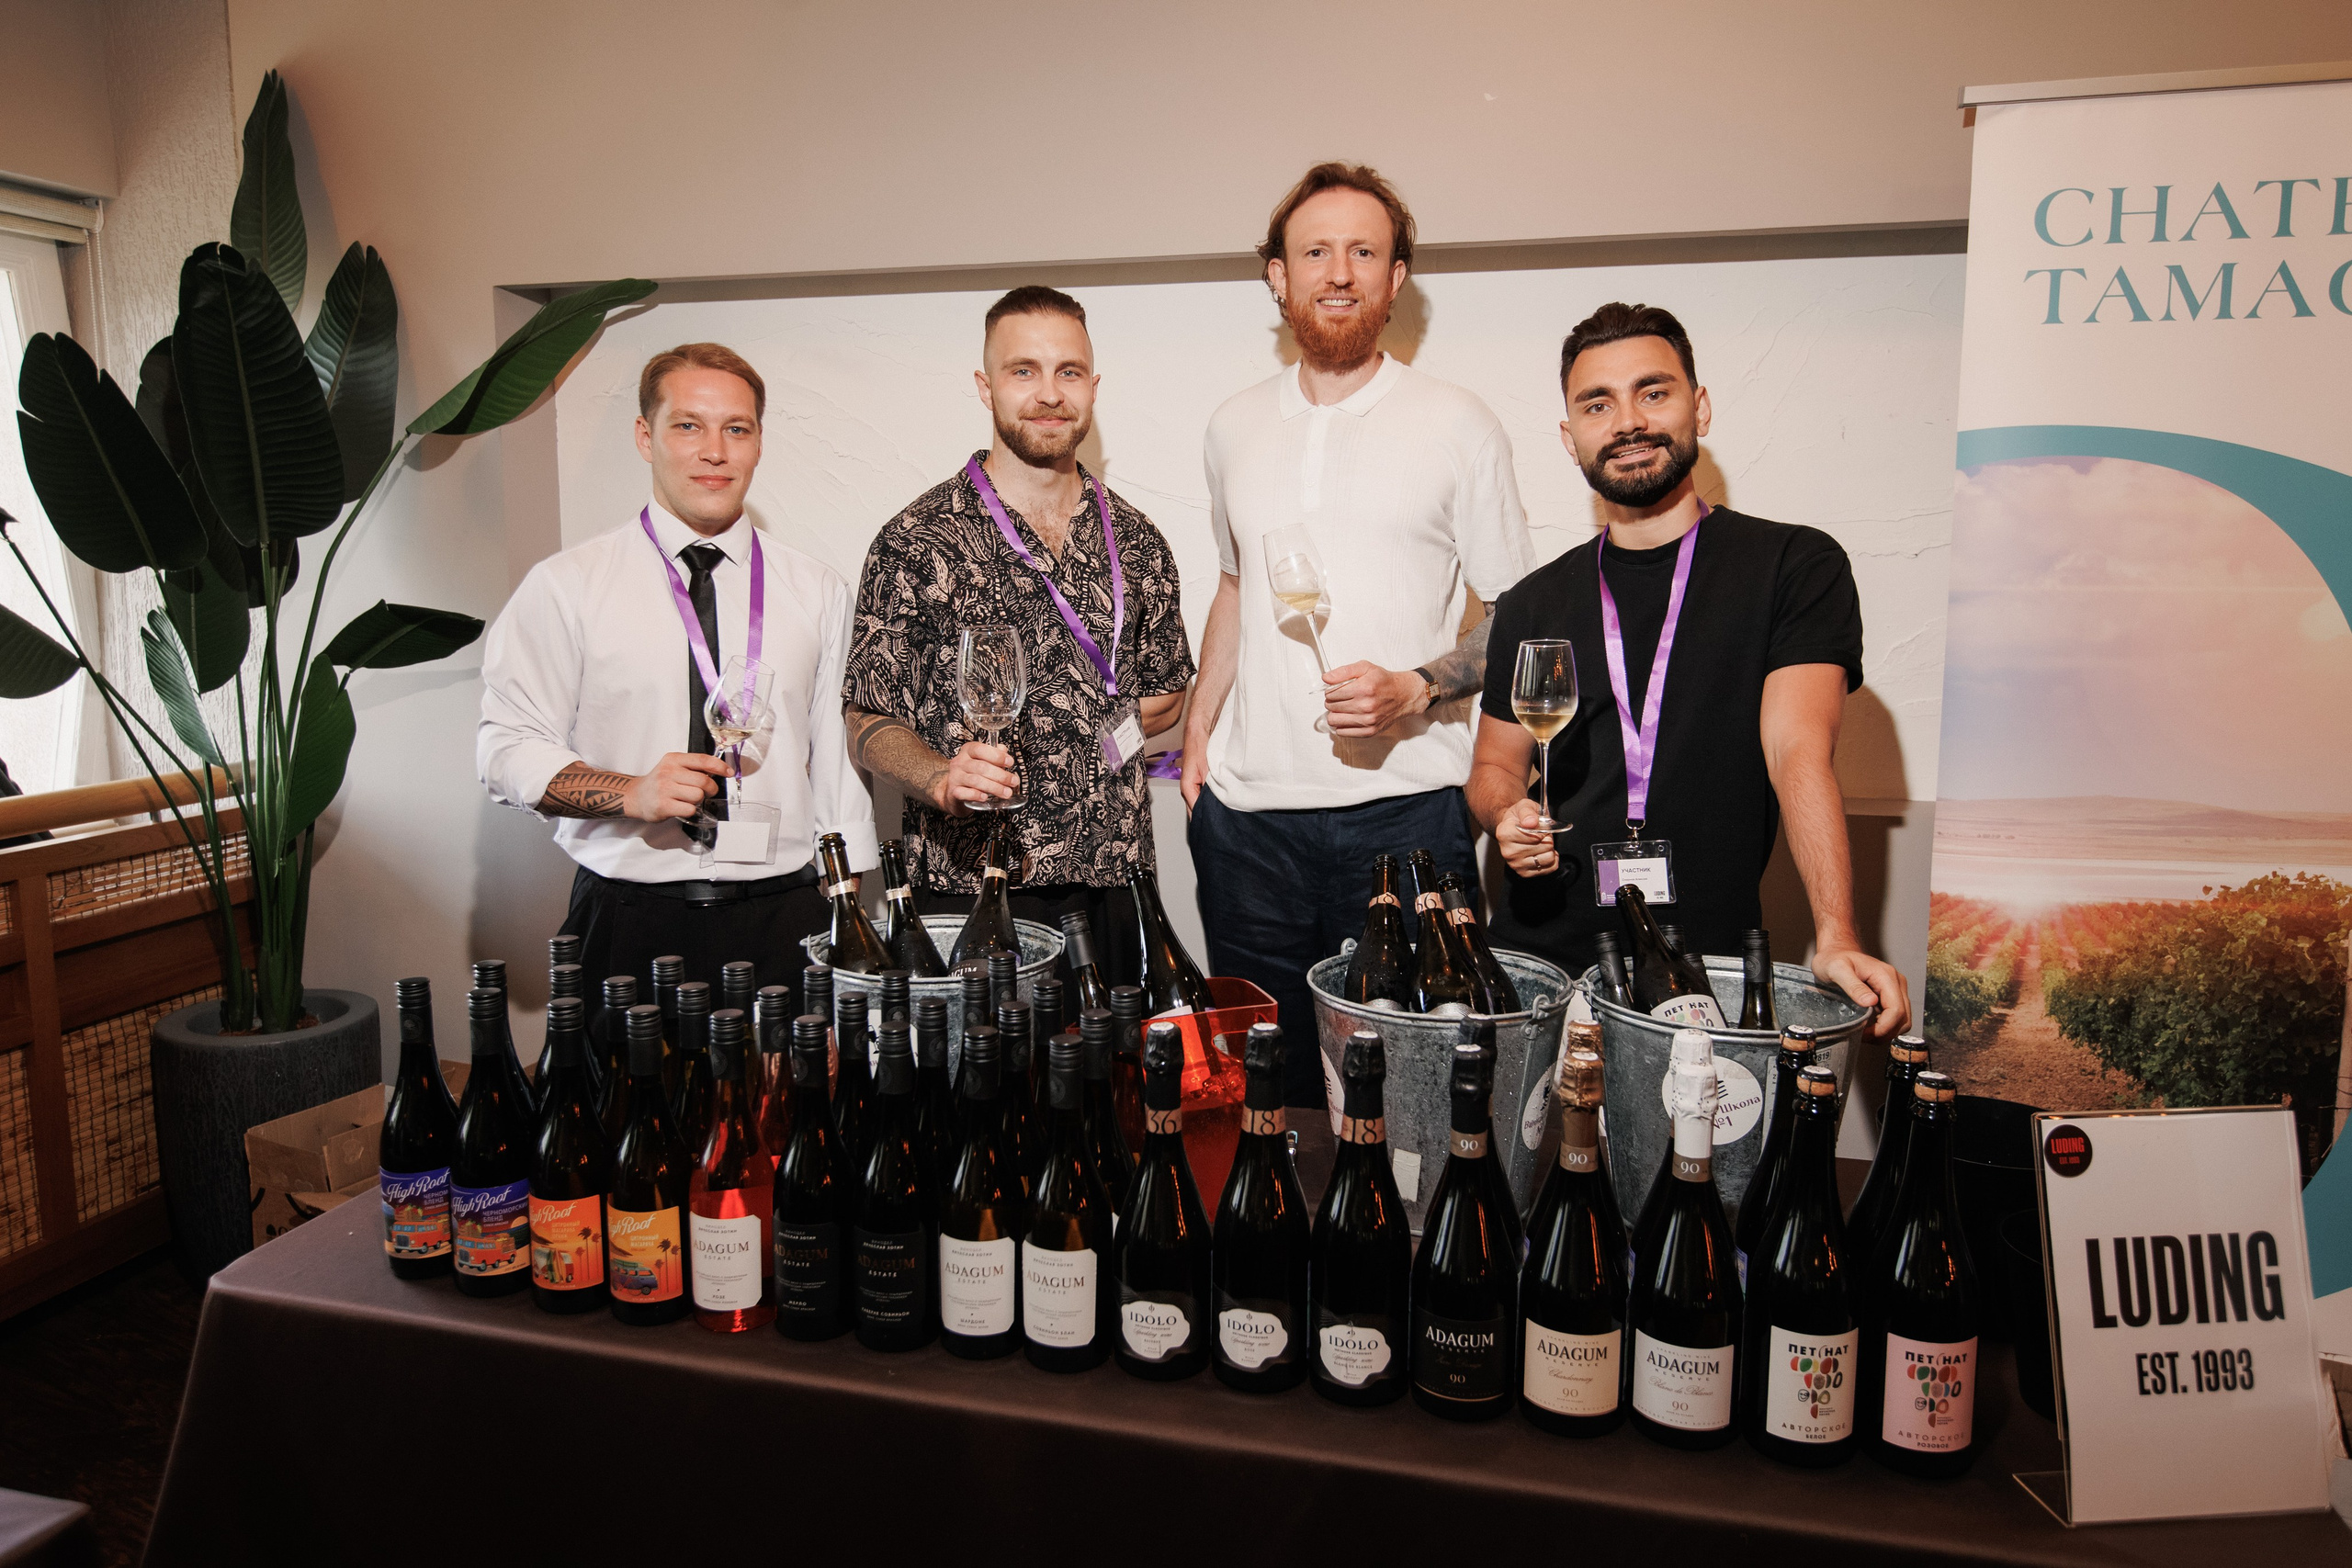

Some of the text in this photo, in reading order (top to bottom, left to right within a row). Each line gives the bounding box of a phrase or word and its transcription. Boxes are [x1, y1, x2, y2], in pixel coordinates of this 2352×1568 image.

[1664, 1005, 1684, 1017] ПЕТ
[1719, 1096, 1761, 1114] Школа
[1251, 1110, 1275, 1135] 18
[1351, 1118, 1377, 1145] 18
[1460, 1139, 1478, 1151] 90
[2051, 1137, 2086, 1155] LUDING
[1568, 1152, 1588, 1165] 90
[1680, 1161, 1700, 1174] 90
[387, 1168, 451, 1203] High Roof
[424, 1197, 445, 1206] БЛЕНД
[452, 1186, 513, 1217] High Roof
[482, 1215, 504, 1224] БЛЕНД
[542, 1201, 579, 1224] Roof
[621, 1213, 657, 1235] Roof
[694, 1239, 750, 1255] ADAGUM
[774, 1243, 829, 1260] ADAGUM
[783, 1259, 810, 1268] ESTATE
[857, 1255, 916, 1270] ADAGUM
[868, 1269, 898, 1278] ESTATE
[944, 1262, 1004, 1278] ADAGUM
[1026, 1269, 1085, 1288] ADAGUM
[2085, 1230, 2286, 1329] LUDING
[1038, 1287, 1067, 1295] ESTATE
[1130, 1311, 1177, 1325] IDOLO
[1227, 1318, 1275, 1335] IDOLO
[1329, 1335, 1379, 1350] IDOLO
[1425, 1325, 1494, 1348] ADAGUM
[1546, 1335, 1580, 1345] SPARKLING
[1432, 1342, 1485, 1354] RESERVE
[1537, 1338, 1608, 1361] ADAGUM
[1657, 1347, 1691, 1358] SPARKLING
[1788, 1343, 1849, 1357] ПЕТ НАТ
[1545, 1356, 1599, 1367] RESERVE
[1646, 1350, 1720, 1375] ADAGUM
[1905, 1350, 1968, 1364] ПЕТ НАТ
[1450, 1373, 1465, 1383] 90
[1548, 1366, 1594, 1384] Chardonnay
[1655, 1368, 1710, 1381] RESERVE
[2135, 1348, 2255, 1395] EST. 1993
[1648, 1375, 1674, 1392] Blanc
[1562, 1387, 1578, 1397] 90
[1671, 1400, 1689, 1411] 90
[1781, 1422, 1846, 1433] АВТОРСКОЕ
[1898, 1430, 1964, 1441] АВТОРСКОЕ
